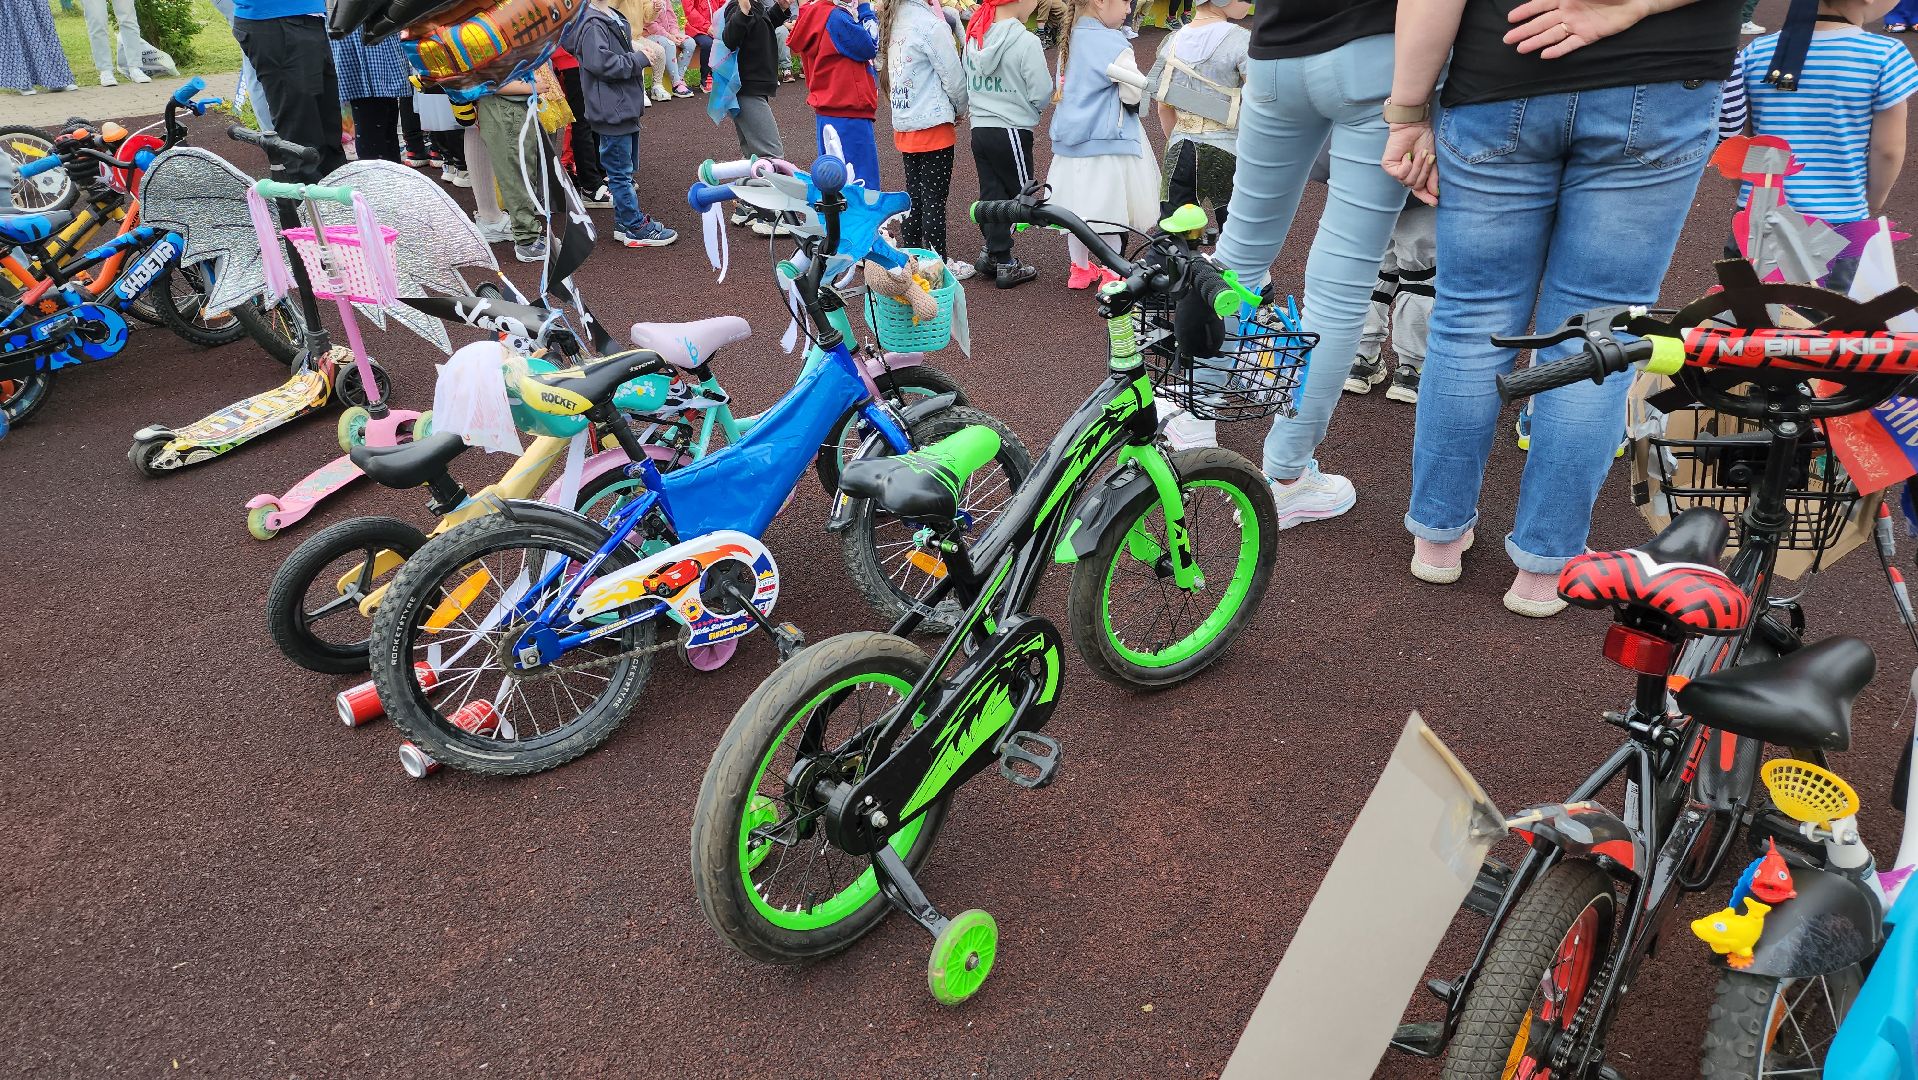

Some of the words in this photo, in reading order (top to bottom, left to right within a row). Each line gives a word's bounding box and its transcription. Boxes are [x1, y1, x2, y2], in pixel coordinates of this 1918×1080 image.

[1839, 337, 1895, 355] KID
[541, 391, 578, 412] ROCKET
[708, 623, 748, 640] RACING
